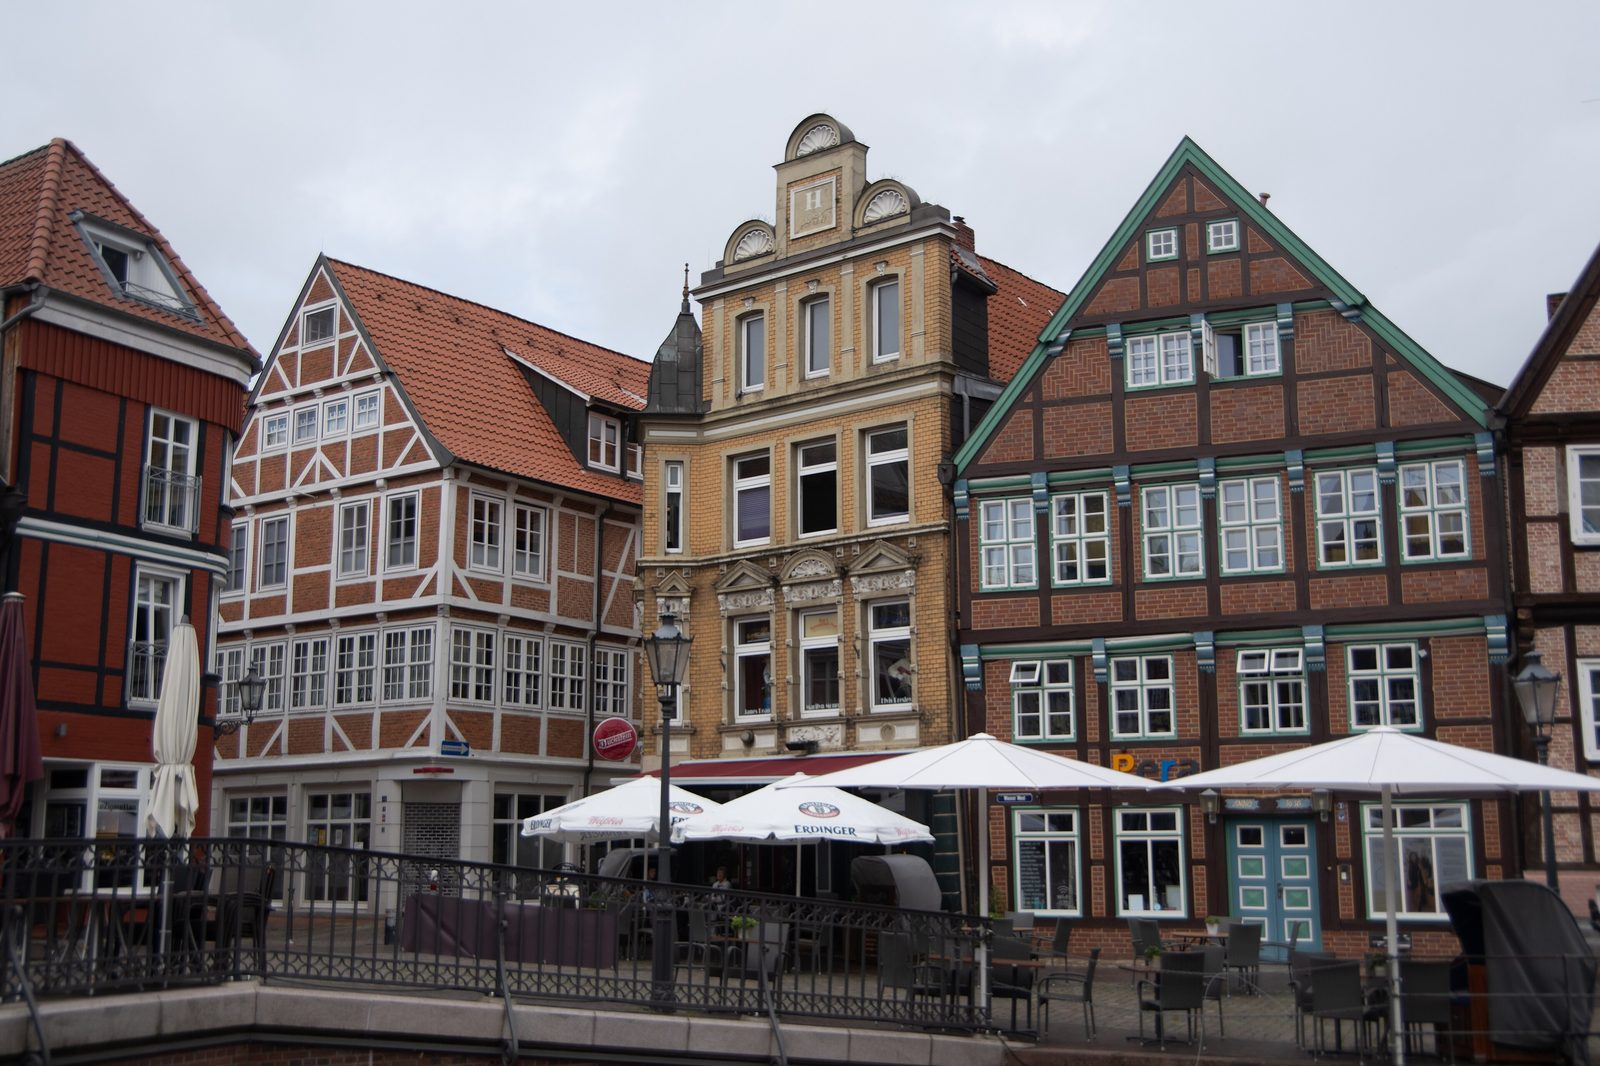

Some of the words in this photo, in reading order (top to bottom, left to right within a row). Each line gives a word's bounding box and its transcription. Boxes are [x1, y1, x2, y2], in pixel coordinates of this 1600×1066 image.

[805, 188, 823, 211] H
[1112, 753, 1199, 783] Pera
[794, 824, 857, 837] ERDINGER
